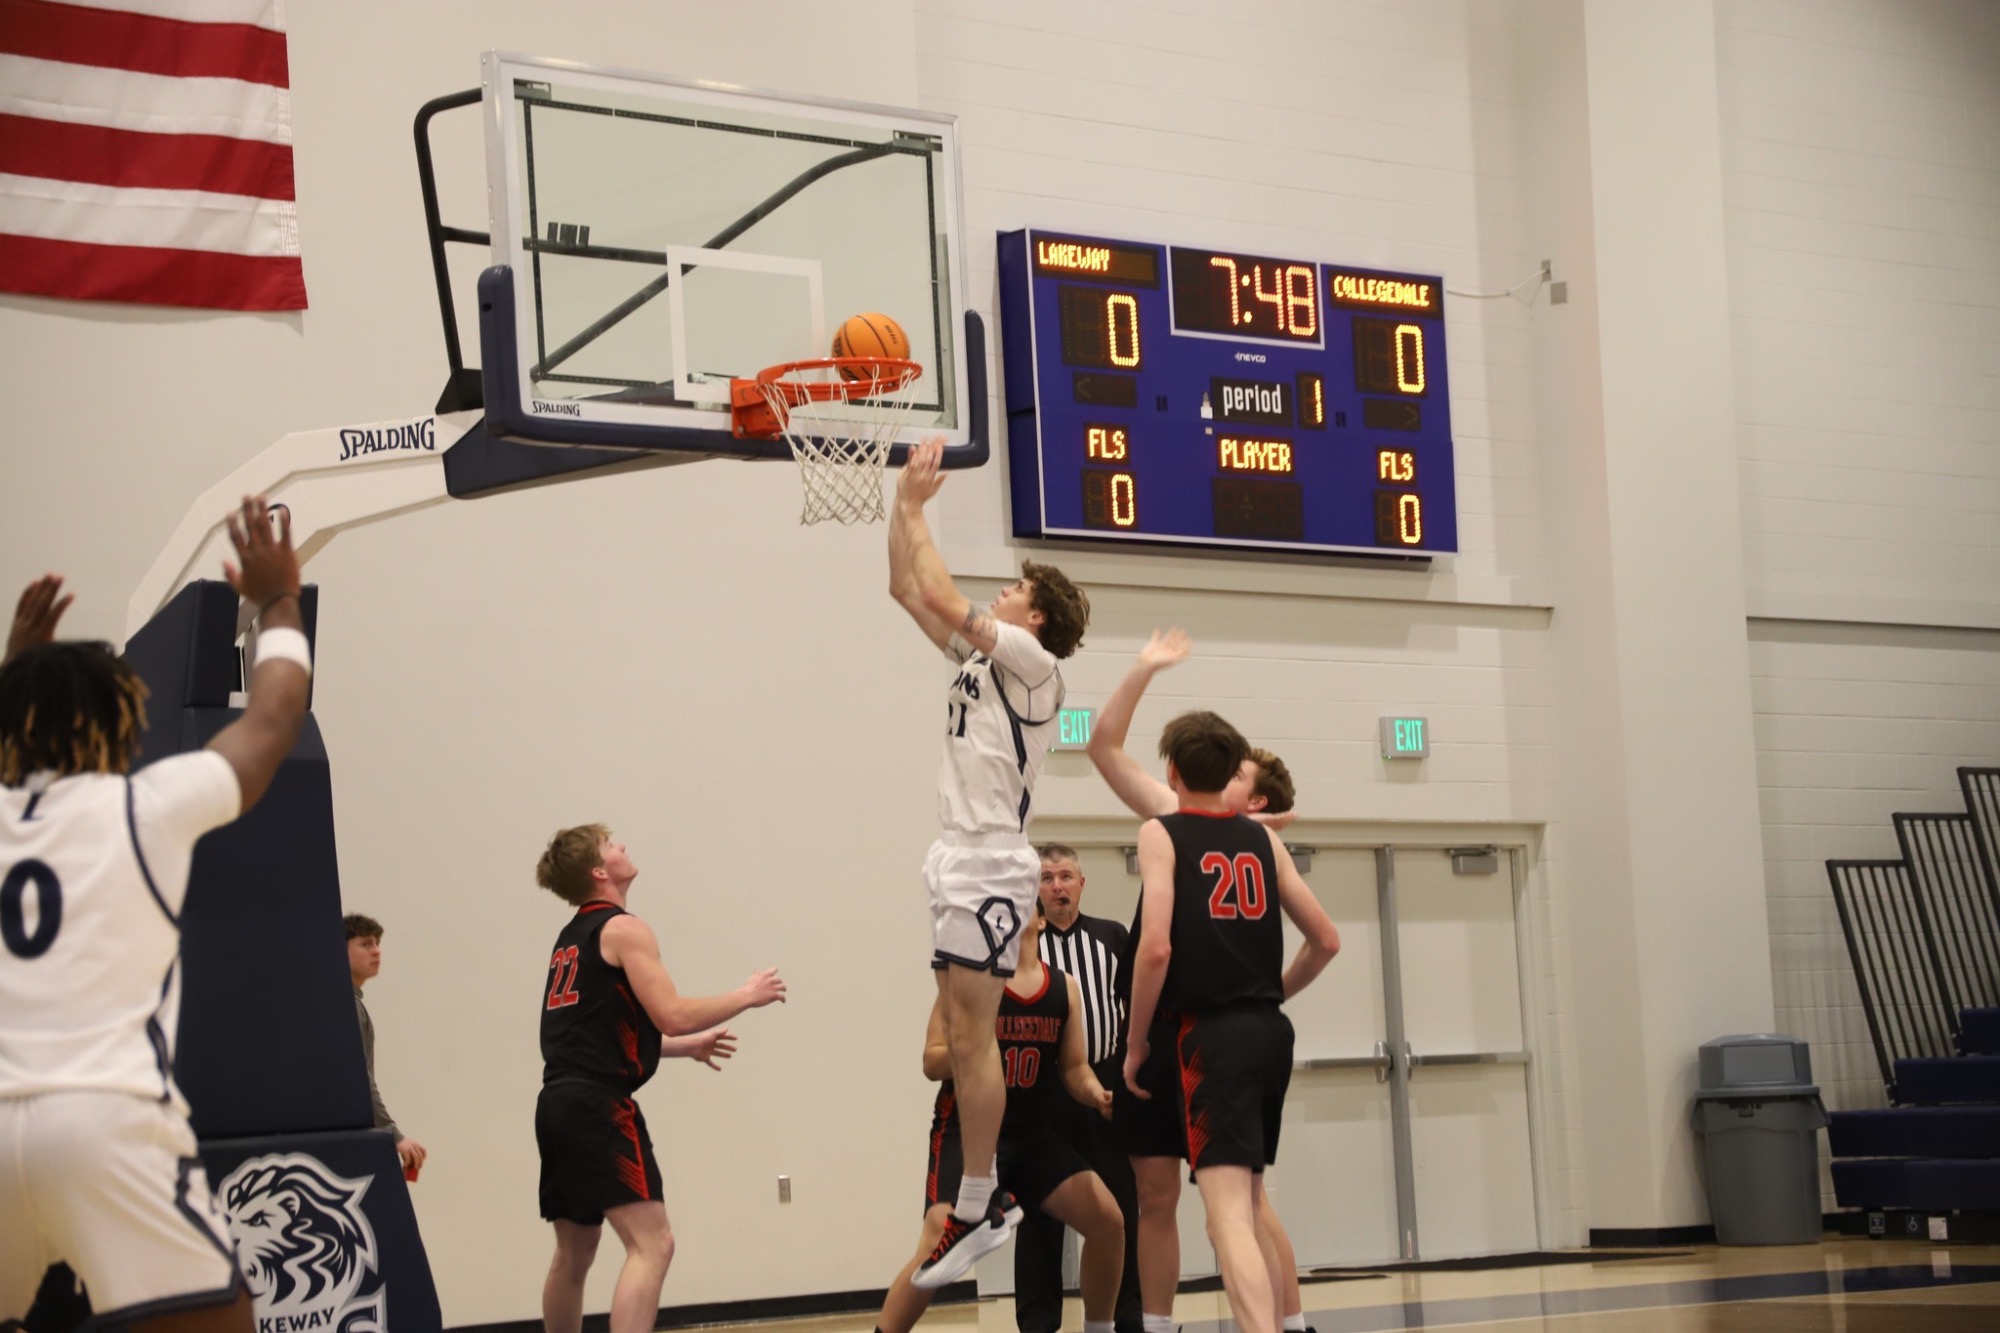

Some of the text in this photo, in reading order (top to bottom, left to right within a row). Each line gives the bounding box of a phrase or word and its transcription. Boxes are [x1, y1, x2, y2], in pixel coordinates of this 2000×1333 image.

[1038, 241, 1110, 272] LAKEWAY
[1210, 256, 1316, 337] 7:48
[1333, 275, 1430, 307] COLLEGEDALE
[1107, 293, 1140, 367] 0
[1395, 323, 1425, 393] 0
[532, 400, 581, 417] SPALDING
[1222, 383, 1283, 416] period
[1314, 379, 1324, 424] 1
[339, 417, 436, 462] SPALDING
[1088, 428, 1126, 460] FLS
[1221, 438, 1292, 472] PLAYER
[1380, 451, 1414, 481] FLS
[1111, 474, 1135, 526] 0
[1400, 494, 1421, 544] 0
[1059, 710, 1091, 744] EXIT
[1395, 719, 1423, 751] EXIT
[1200, 851, 1267, 919] 20
[0, 858, 63, 962] 0
[546, 945, 579, 1010] 22
[1005, 1046, 1041, 1089] 10
